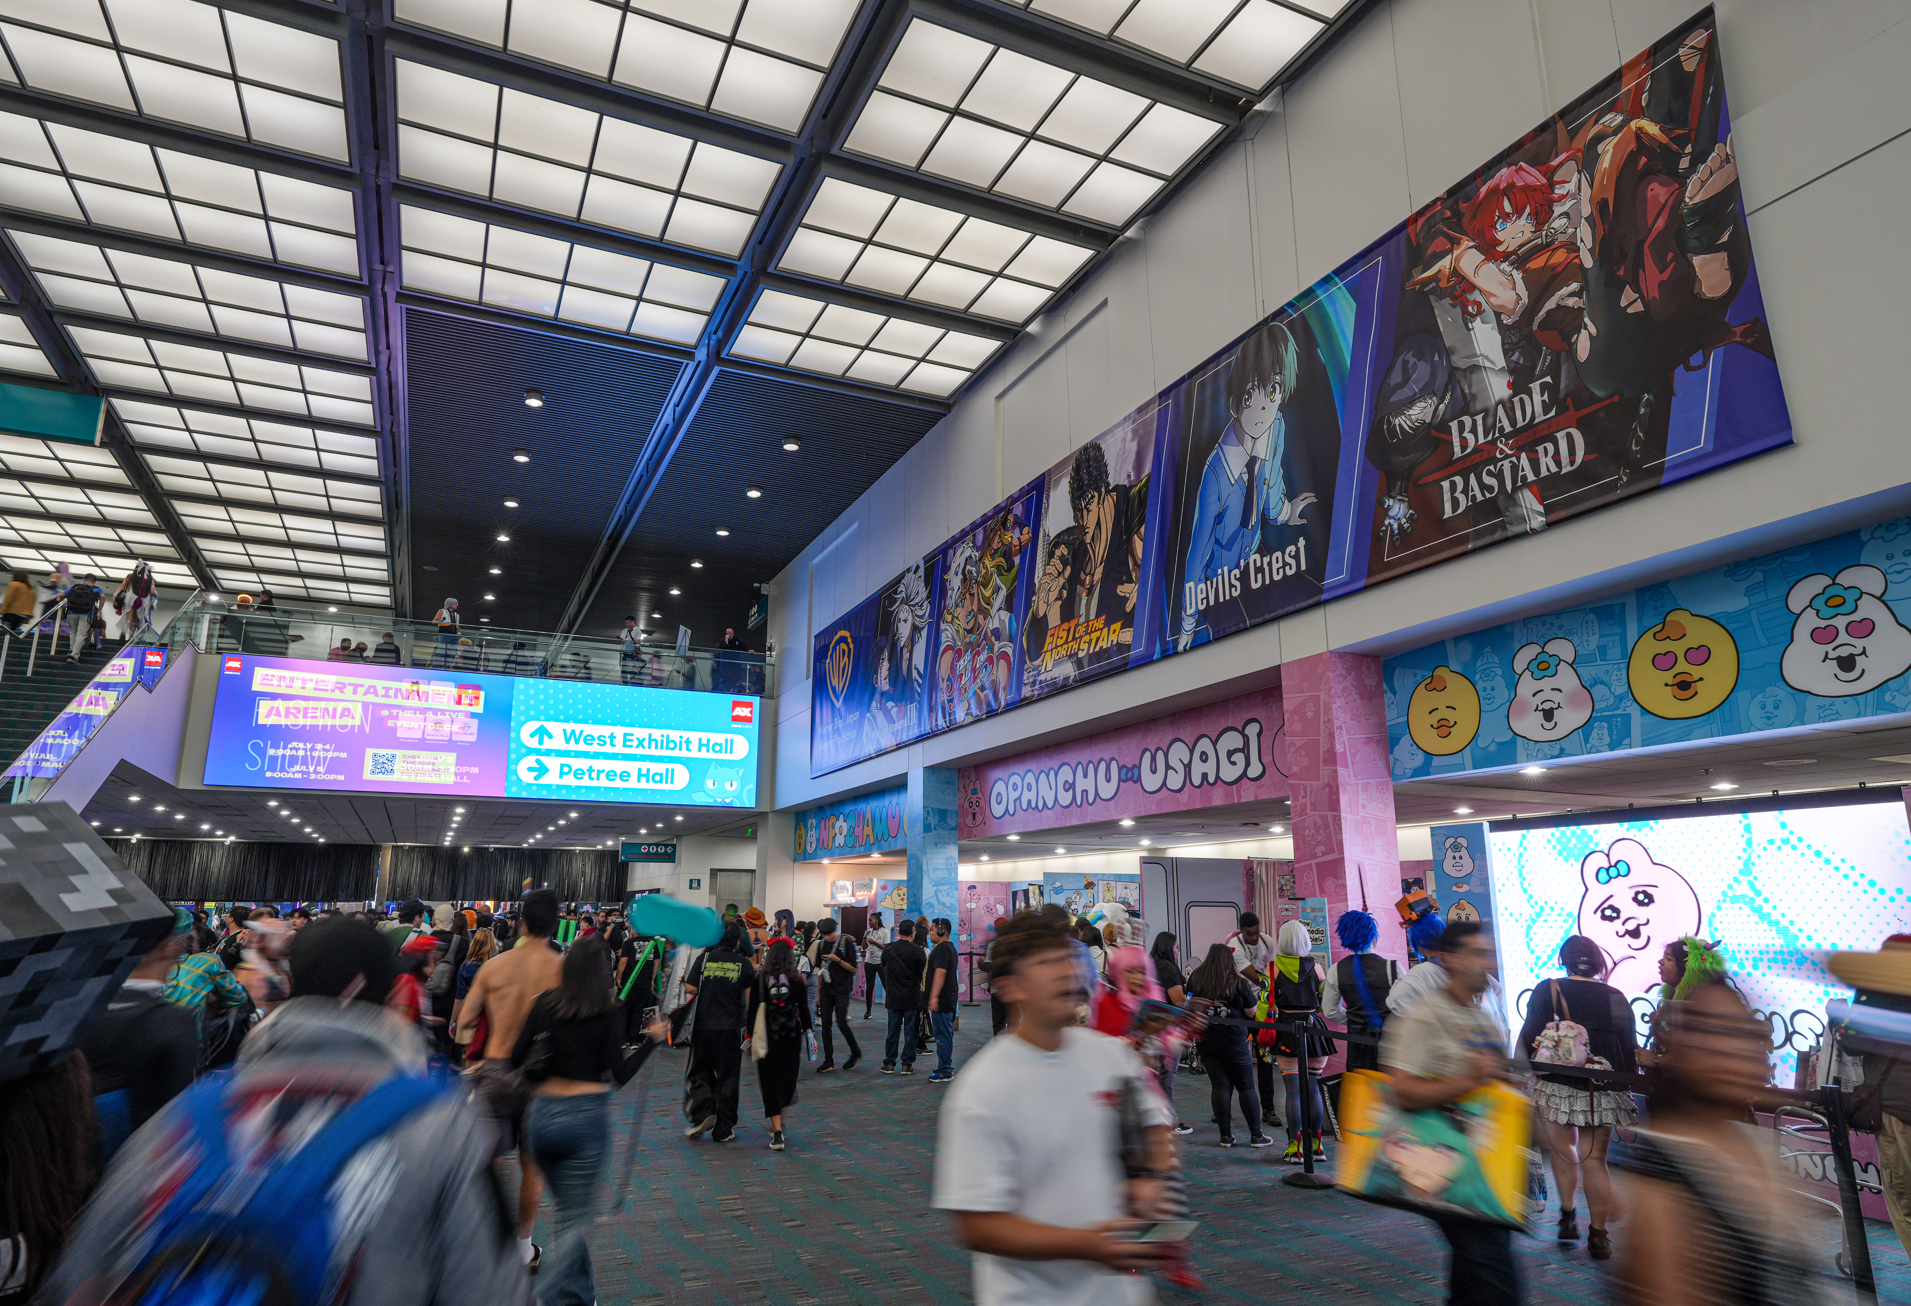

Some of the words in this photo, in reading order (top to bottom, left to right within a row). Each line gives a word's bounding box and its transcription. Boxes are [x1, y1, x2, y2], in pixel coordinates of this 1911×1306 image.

[1448, 375, 1557, 460] BLADE
[1495, 437, 1516, 459] &
[1439, 427, 1585, 519] BASTARD
[1249, 536, 1307, 589] Crest
[1039, 613, 1084, 654] FIST
[1075, 624, 1088, 638] OF
[1087, 614, 1107, 633] THE
[1039, 639, 1080, 675] NORTH
[1078, 619, 1125, 658] STAR
[252, 697, 372, 733] FASHION
[264, 706, 356, 720] ARENA
[245, 739, 336, 774] SHOW
[562, 728, 617, 748] West
[622, 732, 693, 753] Exhibit
[698, 737, 734, 755] Hall
[265, 771, 302, 779] 9:00AM
[559, 763, 632, 781] Petree
[637, 767, 675, 785] Hall
[989, 757, 1121, 819] OPANCHU
[1139, 717, 1267, 795] USAGI
